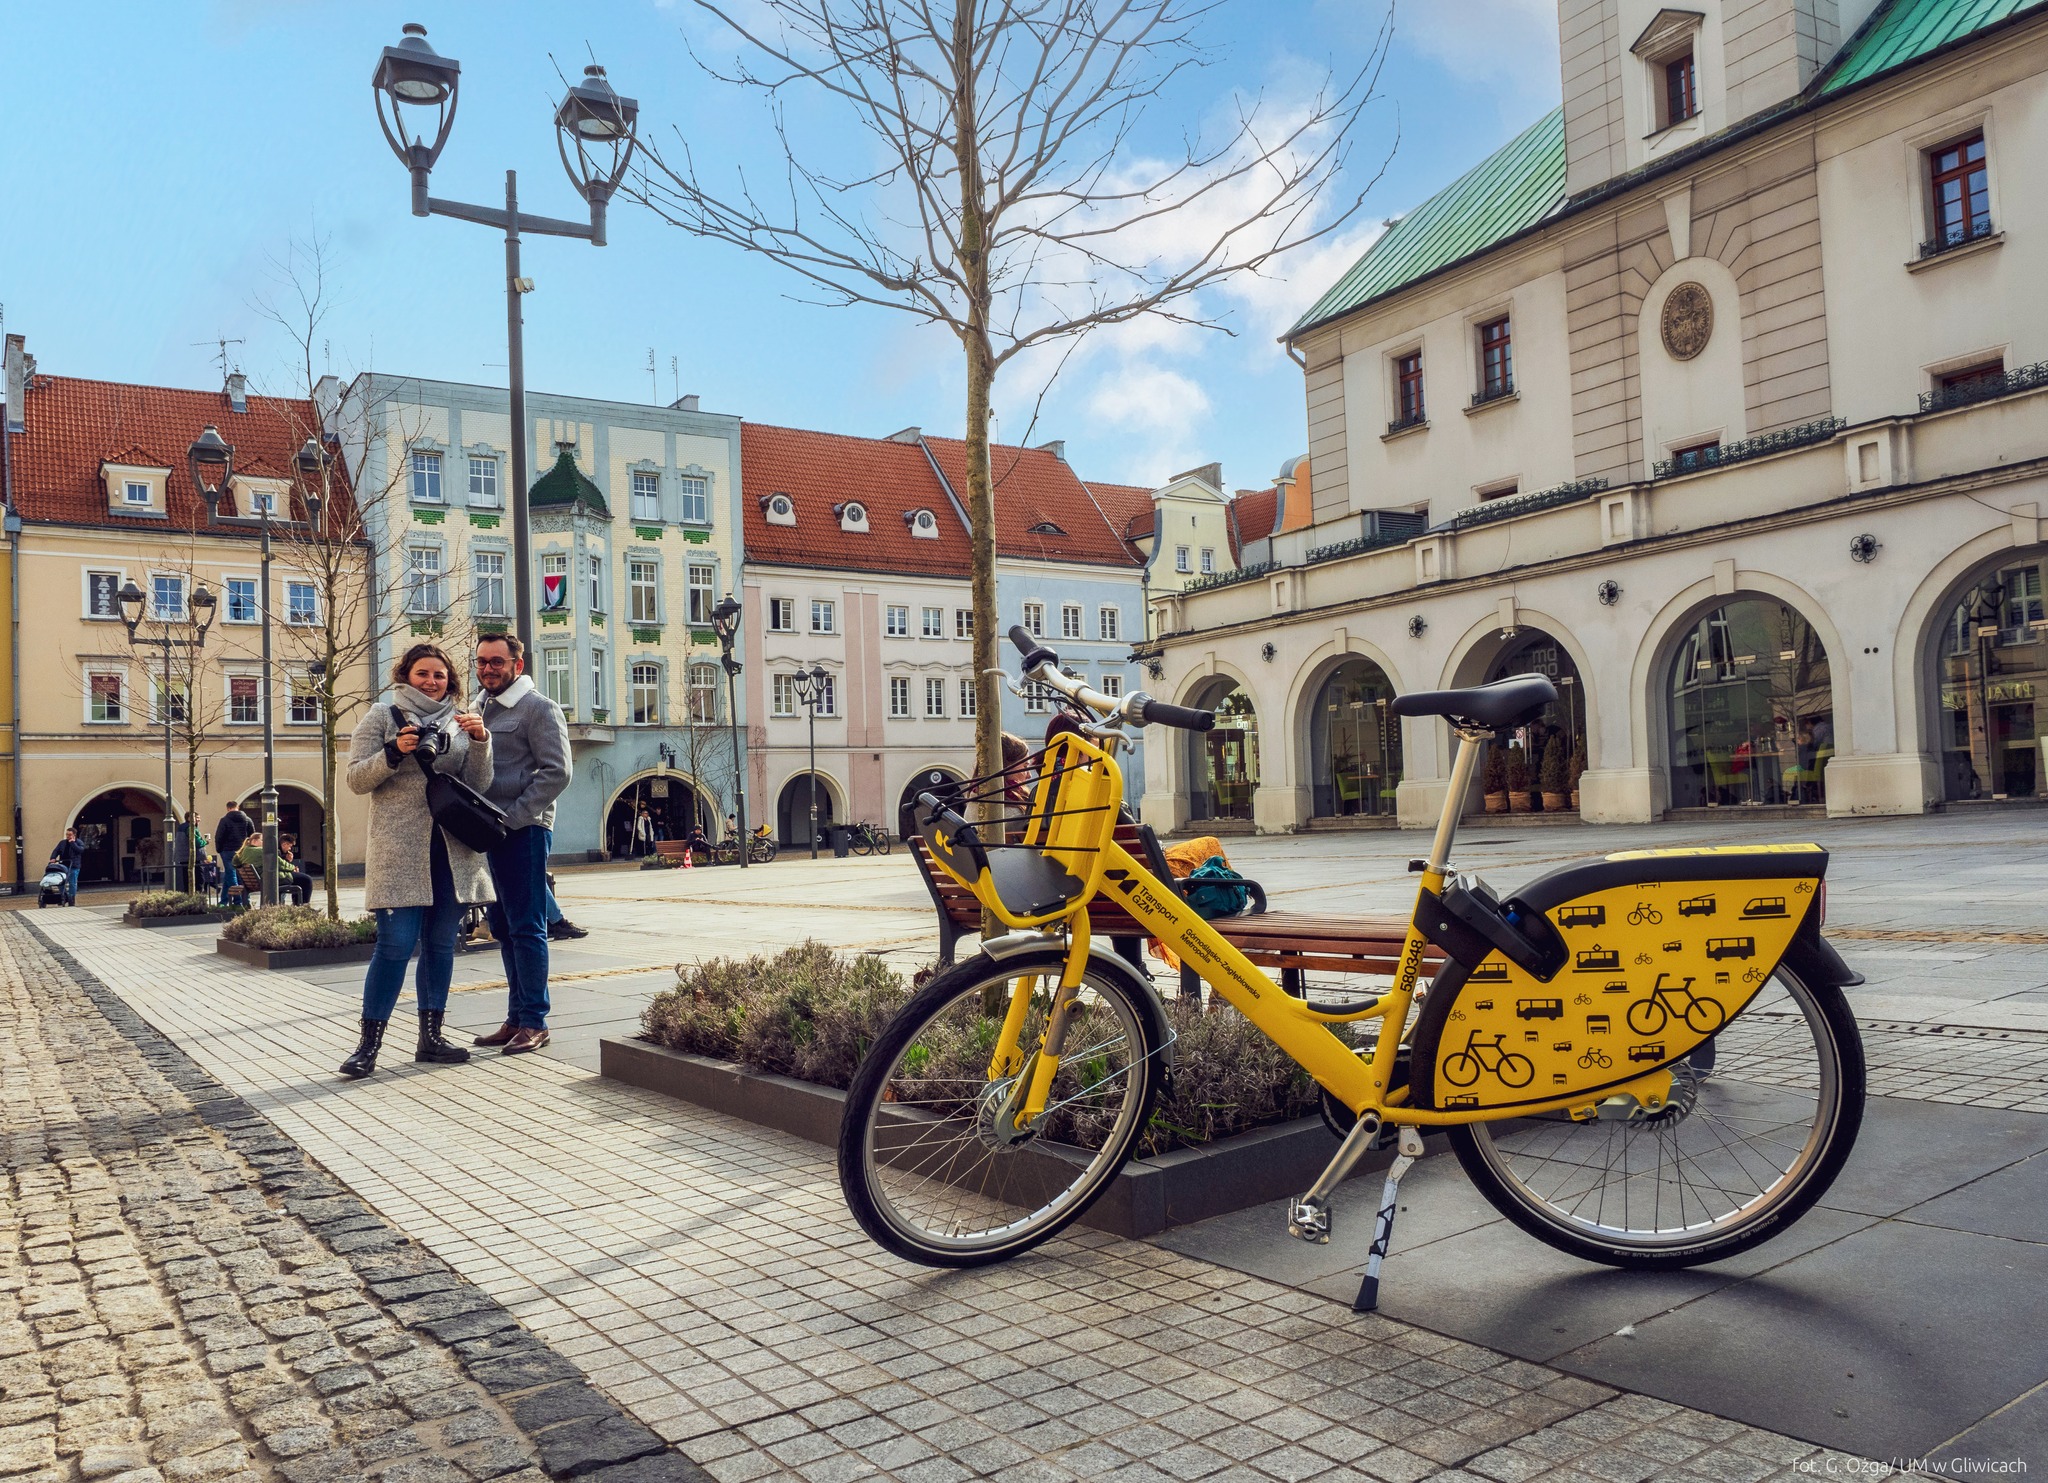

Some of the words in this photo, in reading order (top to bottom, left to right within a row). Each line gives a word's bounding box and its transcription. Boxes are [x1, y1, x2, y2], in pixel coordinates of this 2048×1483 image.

[1132, 894, 1155, 916] GZM
[1139, 886, 1179, 925] Transport
[1180, 933, 1211, 964] Metropolia
[1185, 928, 1261, 1000] Górnośląsko-Zagłębiowska
[1400, 939, 1424, 992] 580348
